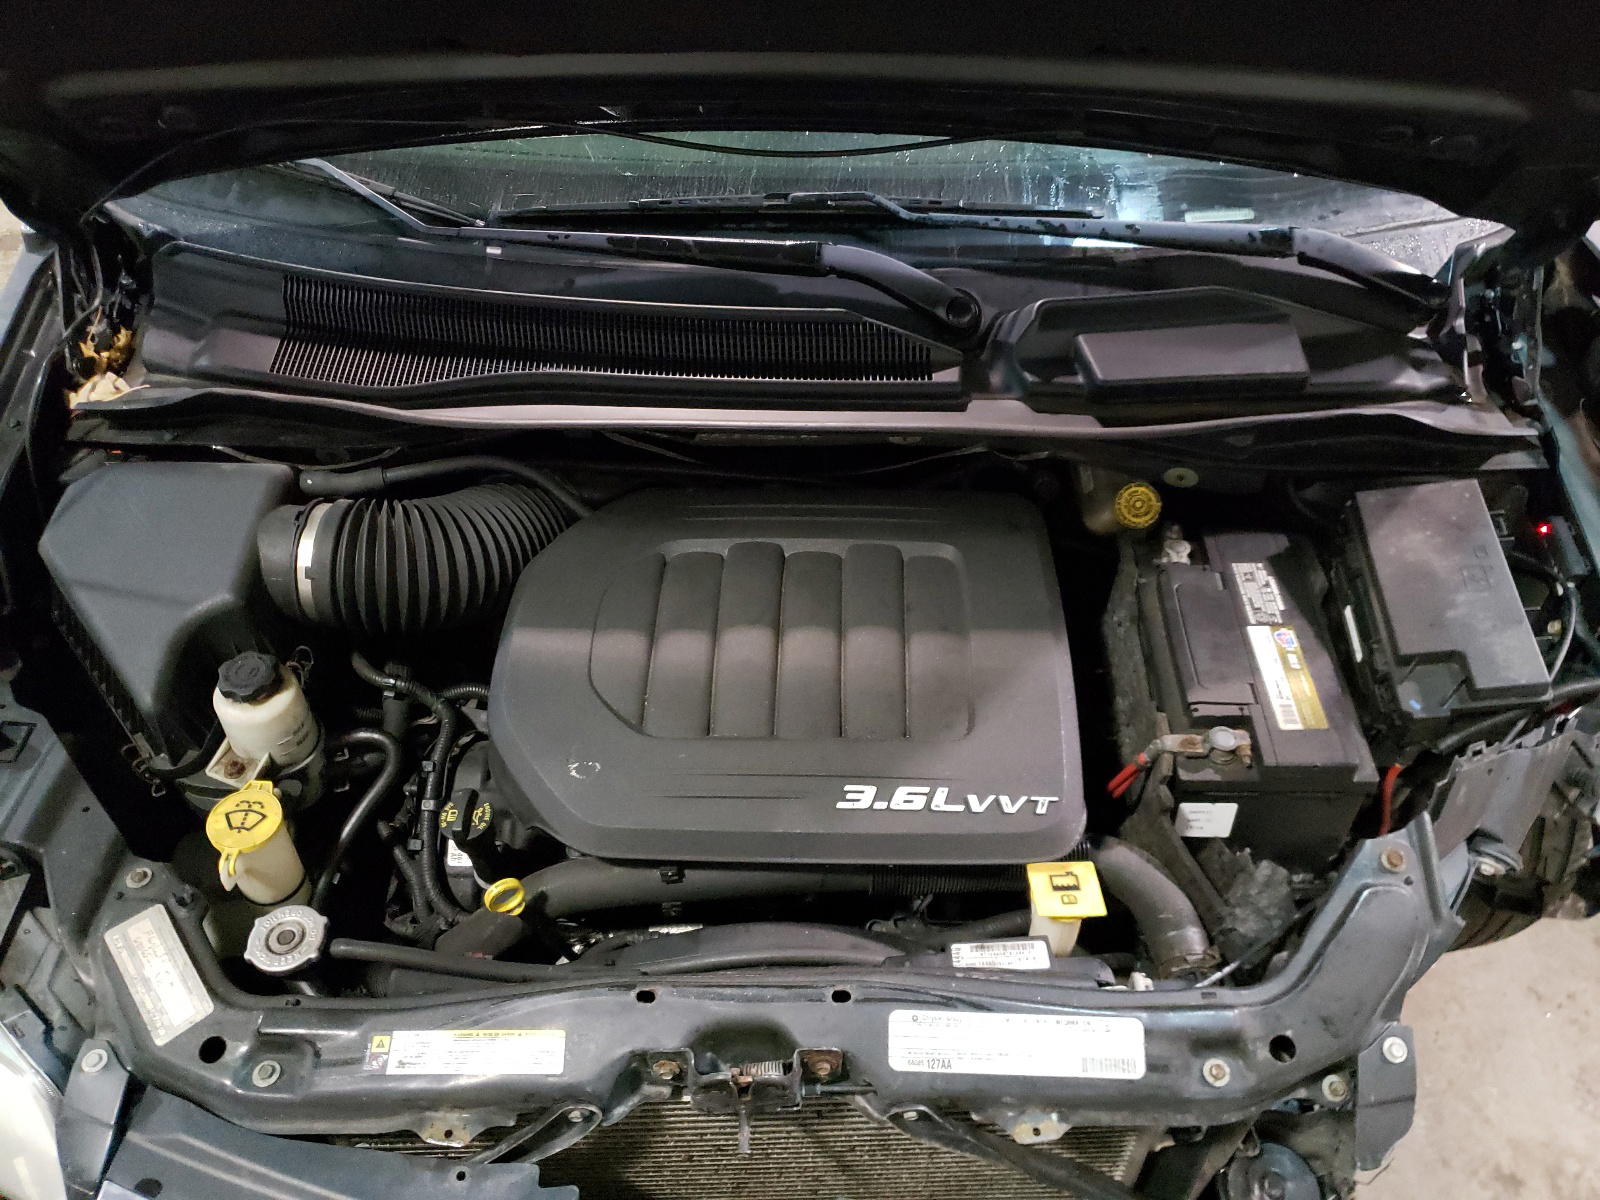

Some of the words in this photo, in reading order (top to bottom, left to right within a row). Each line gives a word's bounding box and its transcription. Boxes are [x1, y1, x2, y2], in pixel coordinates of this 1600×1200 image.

[835, 784, 966, 812] 3.6L
[966, 794, 1060, 815] VVT
[927, 1057, 953, 1070] 127AA
